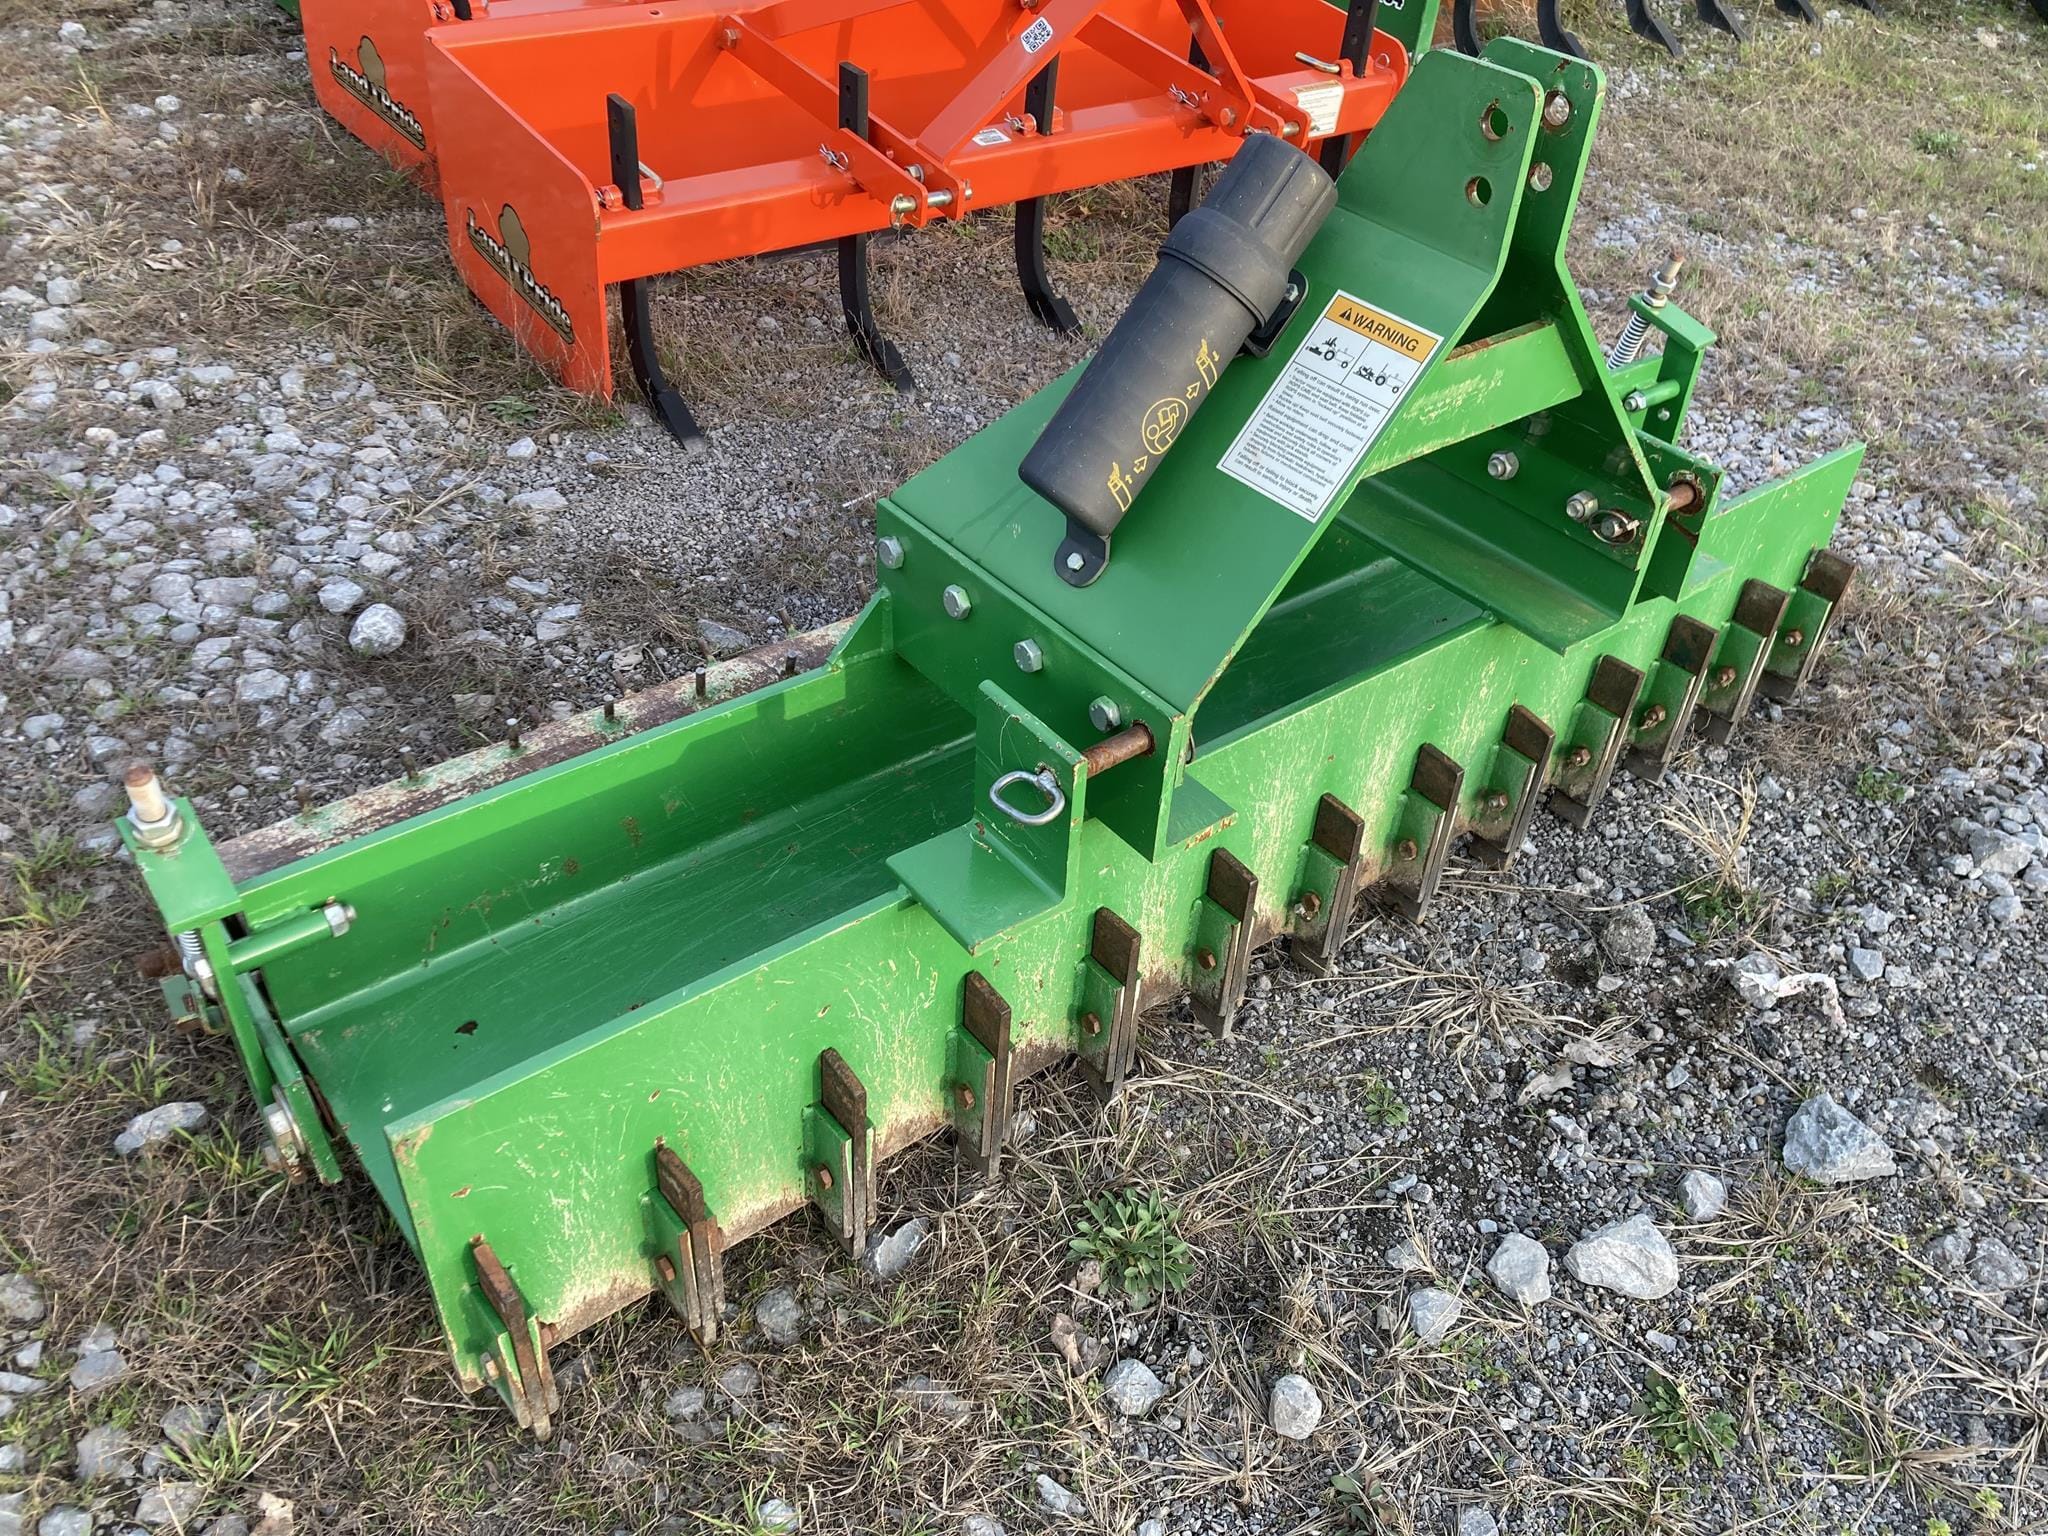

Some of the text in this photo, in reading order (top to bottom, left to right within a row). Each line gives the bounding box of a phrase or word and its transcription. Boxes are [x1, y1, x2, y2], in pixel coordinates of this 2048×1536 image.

[330, 47, 423, 139] Land Pride
[468, 208, 572, 330] Land Pride
[1353, 312, 1418, 352] WARNING
